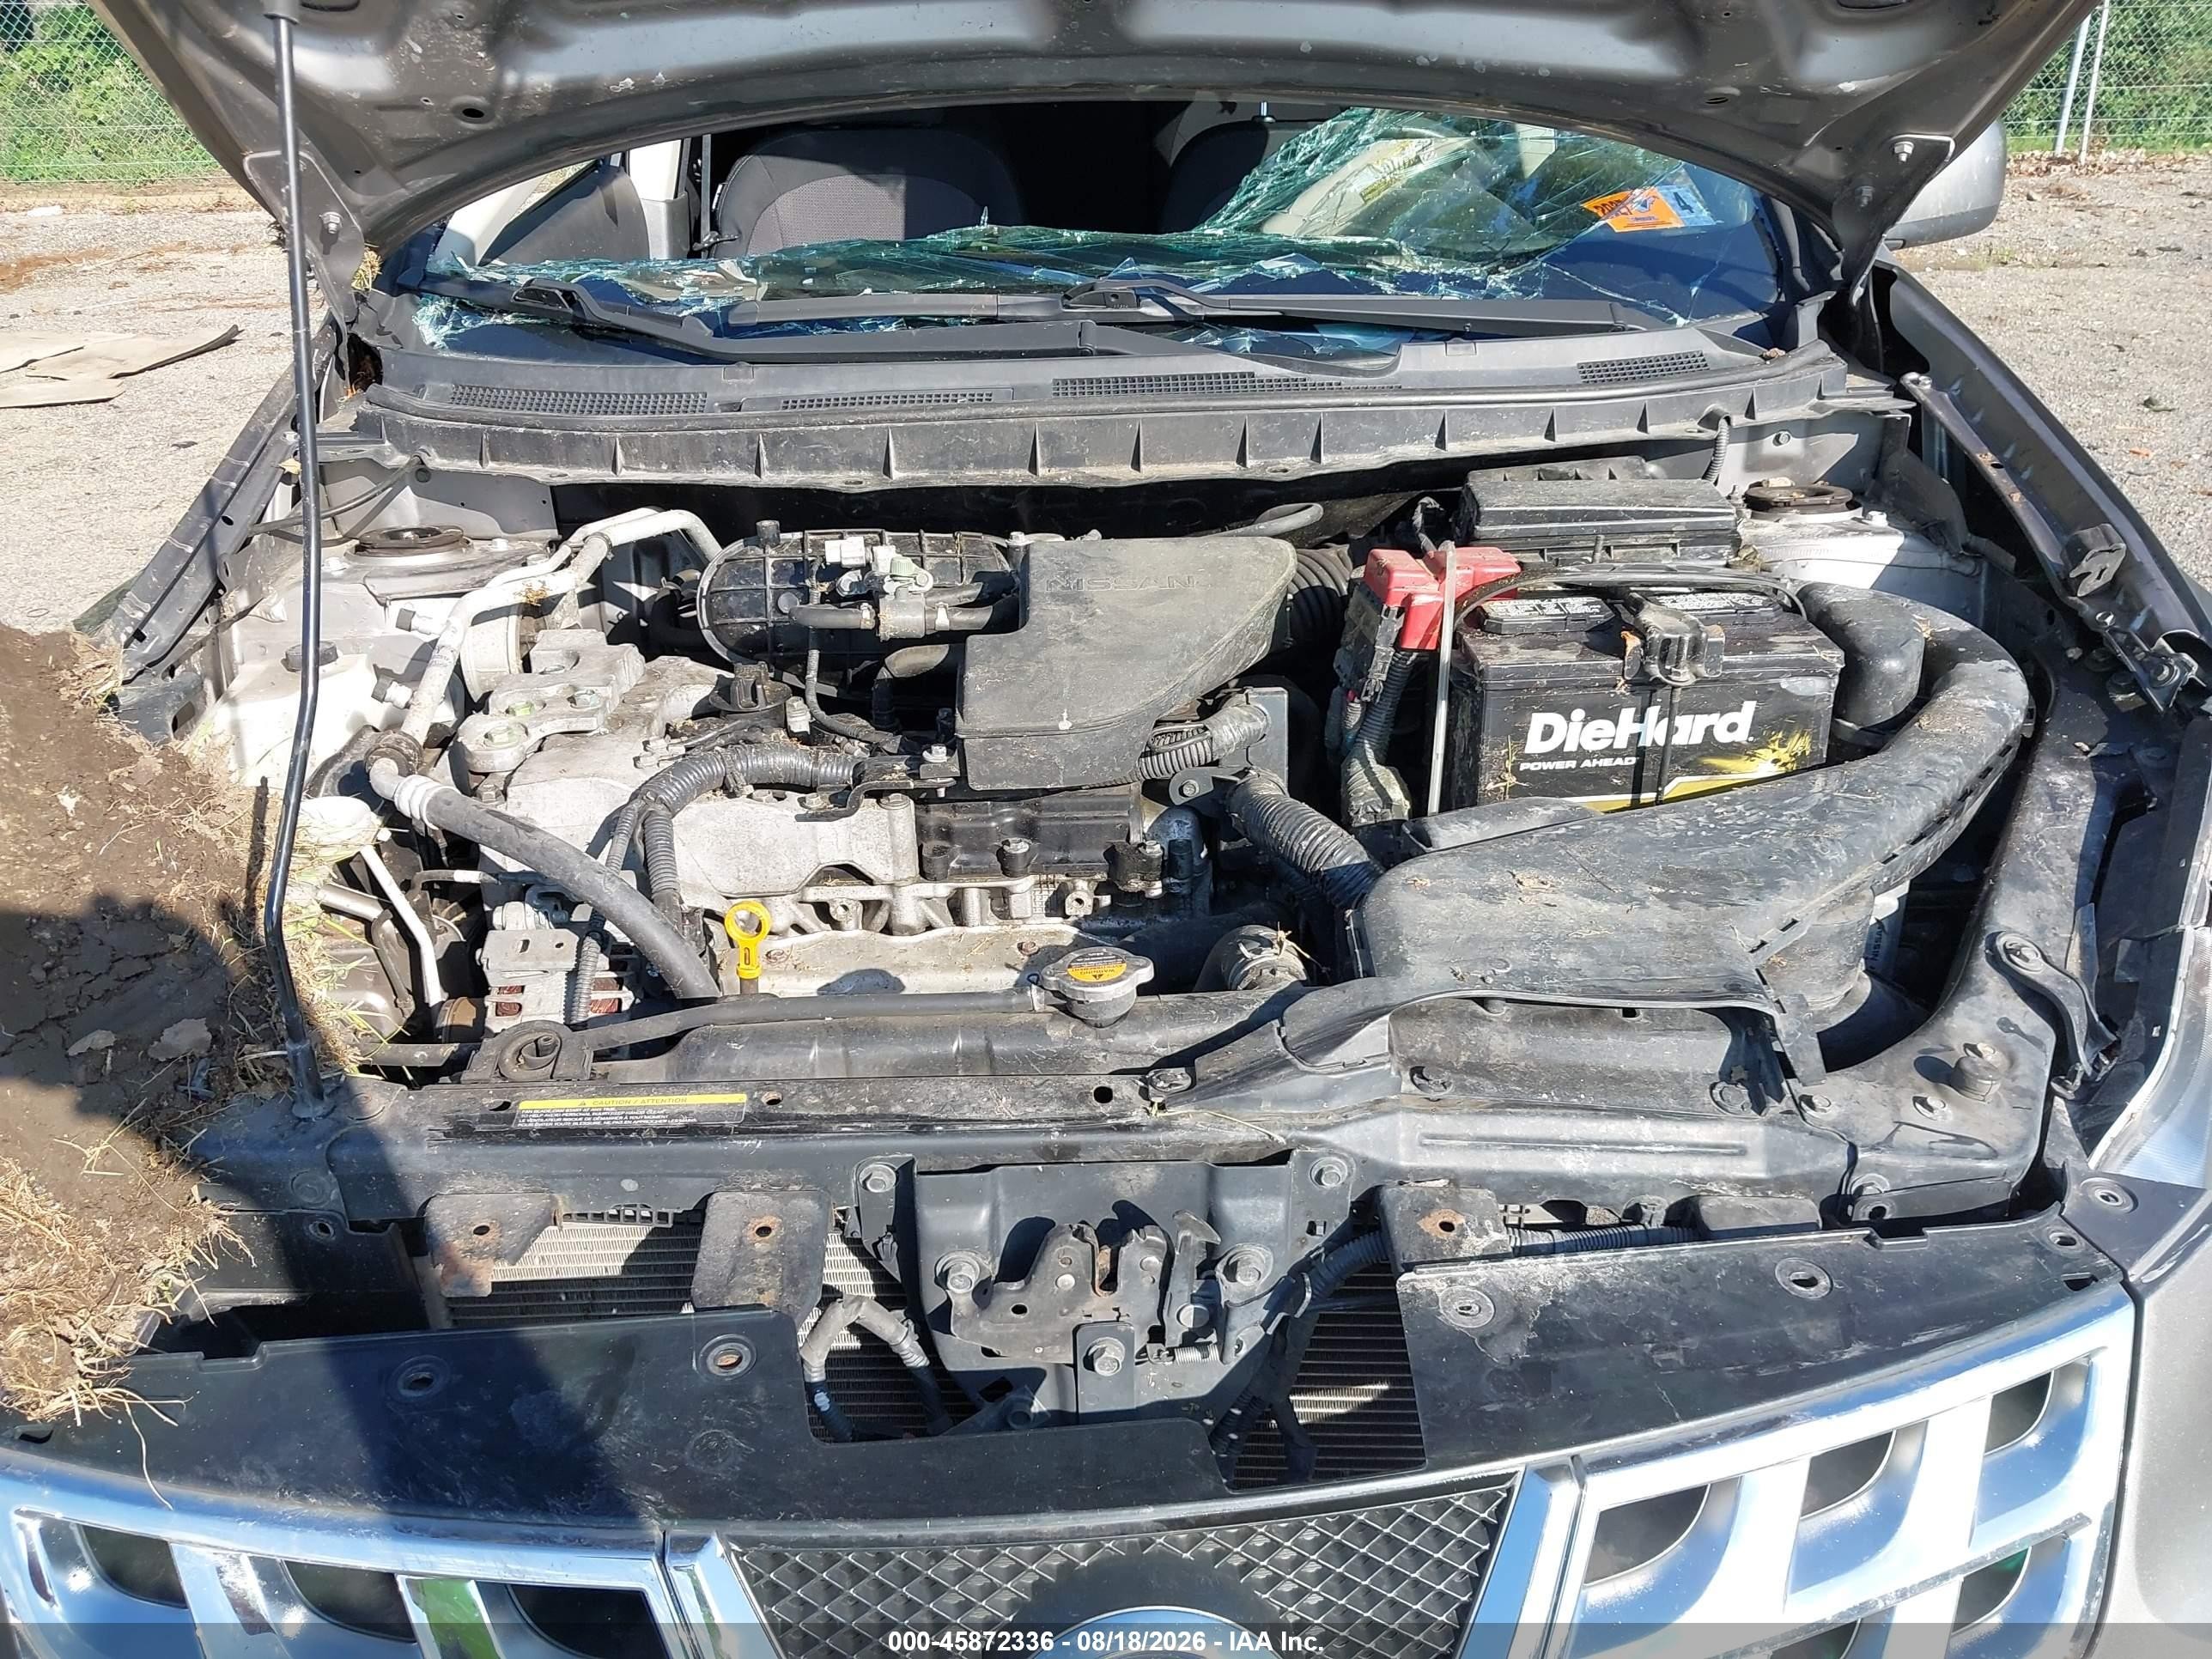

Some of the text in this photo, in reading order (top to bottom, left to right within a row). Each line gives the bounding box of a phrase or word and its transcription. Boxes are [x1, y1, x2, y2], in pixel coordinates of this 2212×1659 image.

[1673, 191, 1695, 213] 4
[1045, 575, 1196, 592] NISSAN
[1524, 701, 1756, 754] DieHard
[1519, 756, 1636, 771] POWER AHEAD
